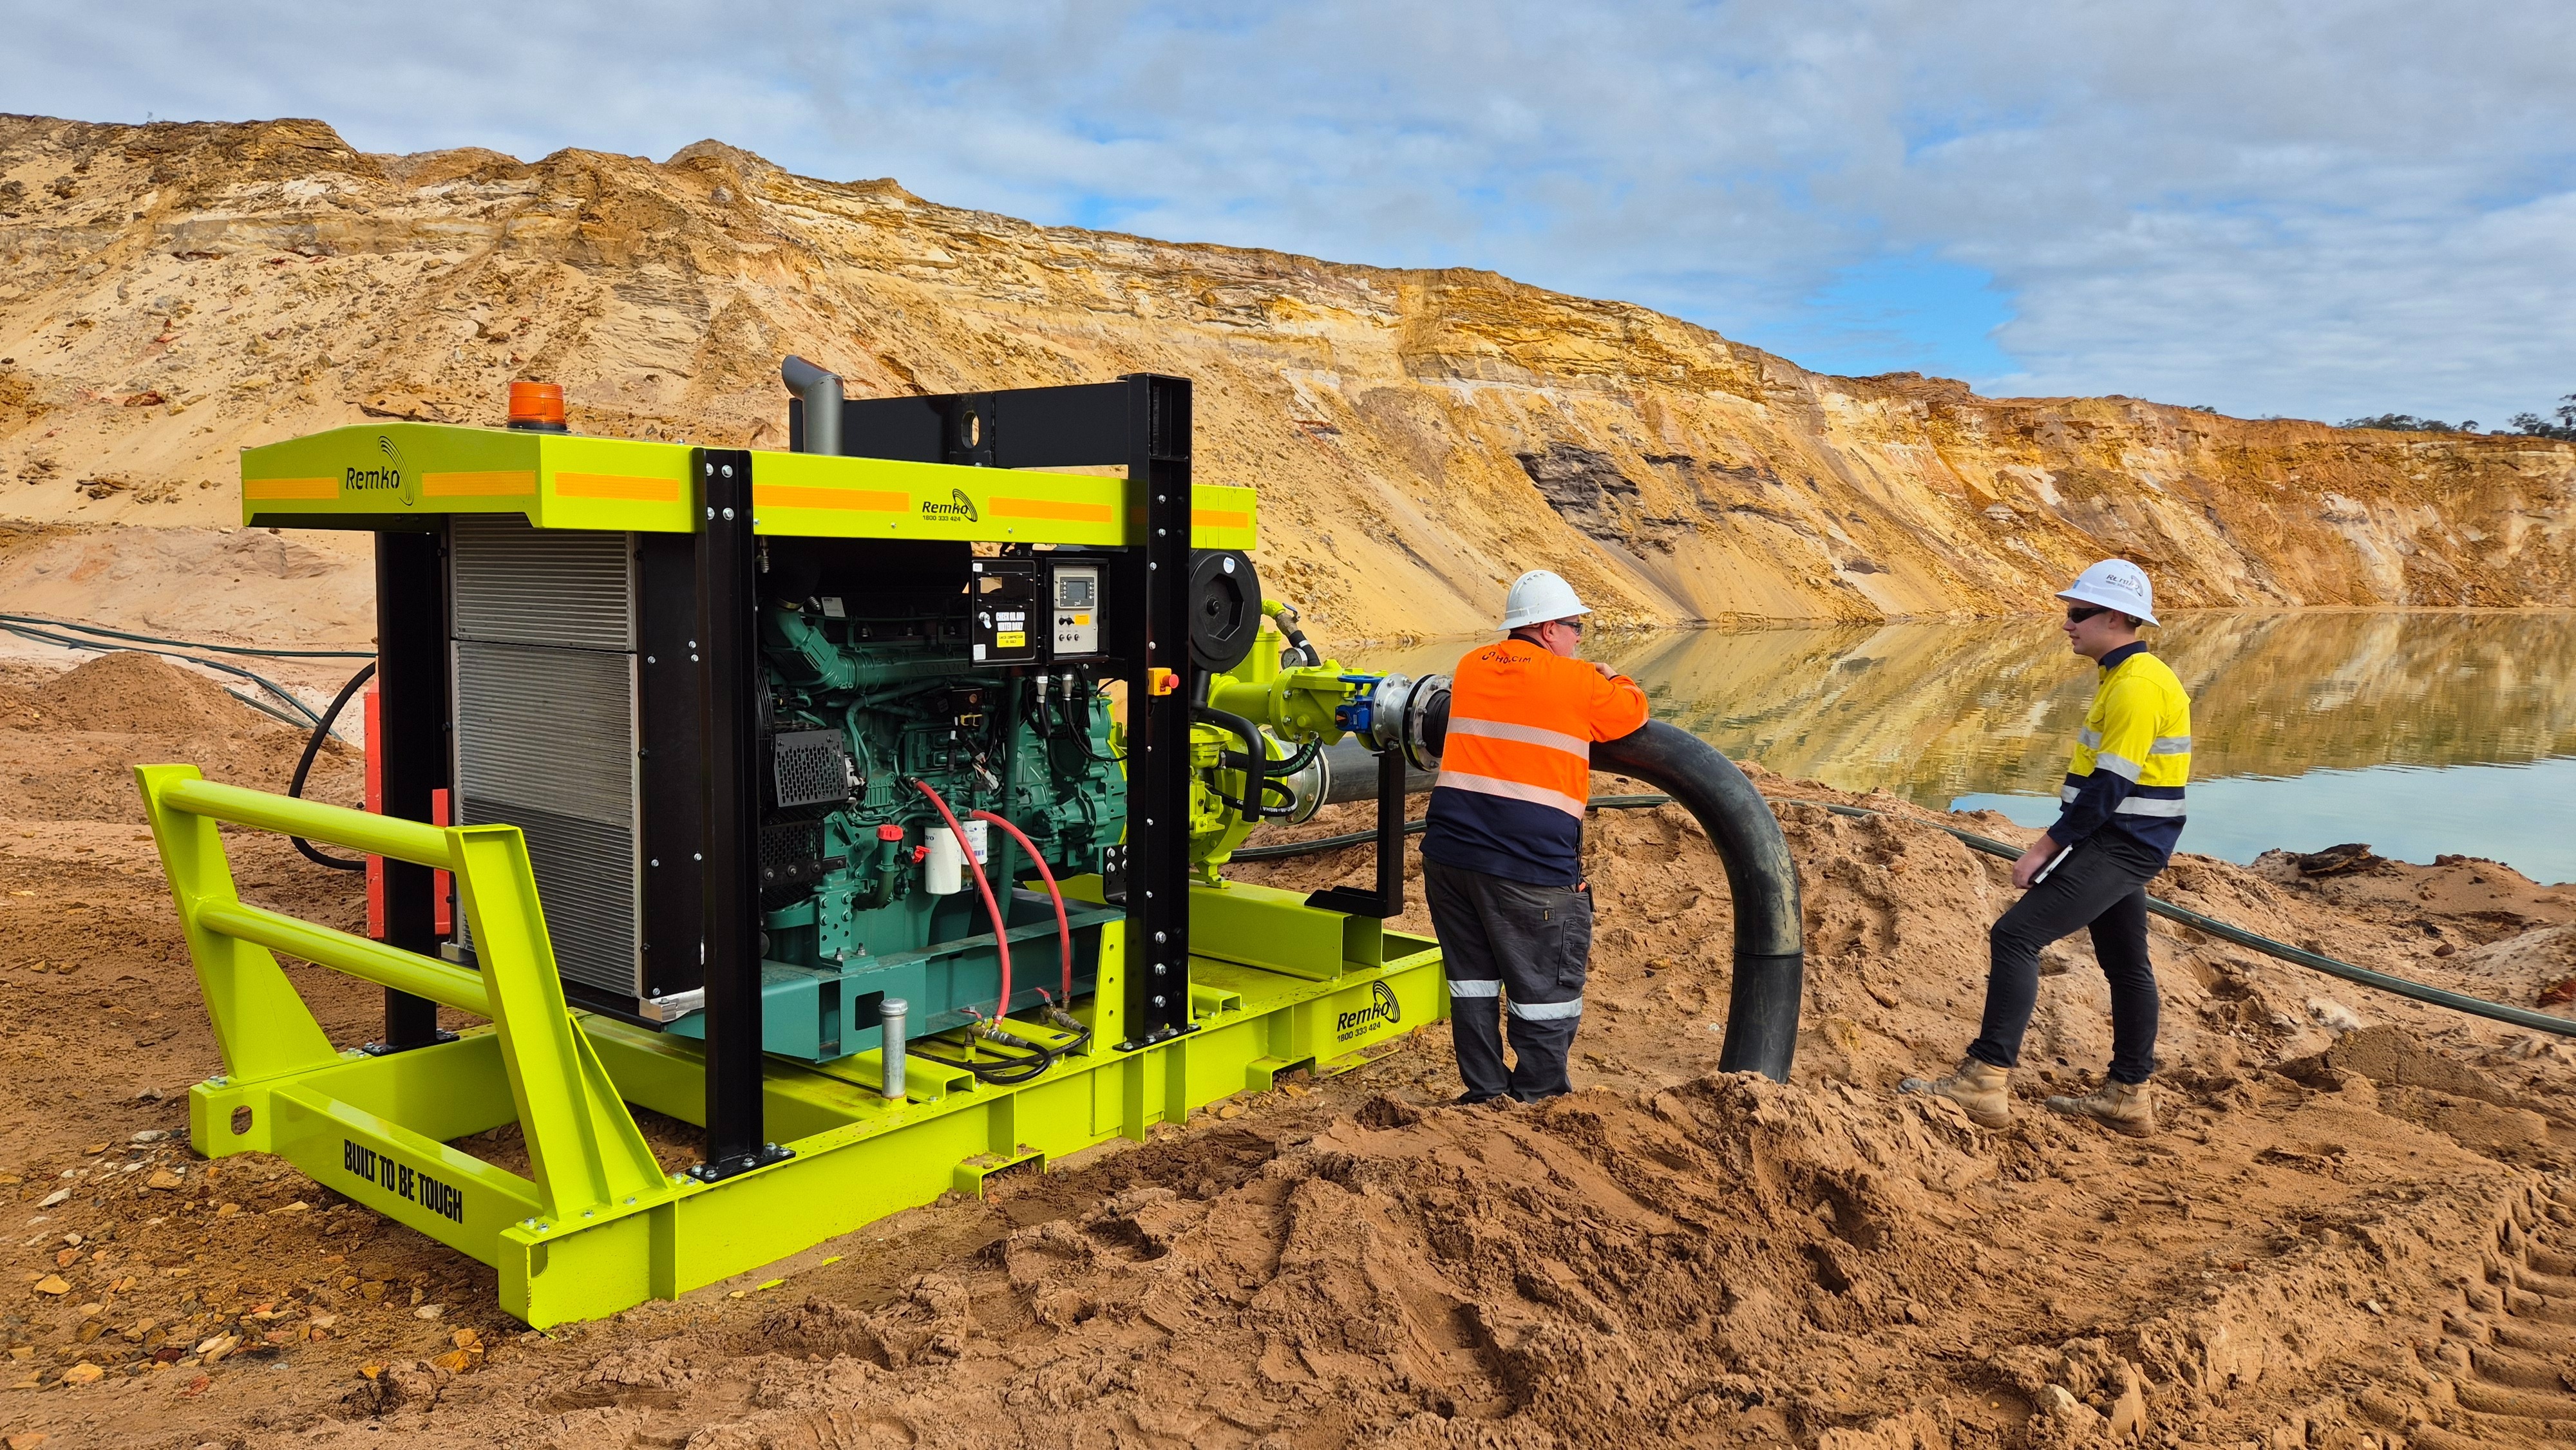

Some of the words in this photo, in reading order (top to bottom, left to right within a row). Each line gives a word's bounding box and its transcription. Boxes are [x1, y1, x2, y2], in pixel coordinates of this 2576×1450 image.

[346, 466, 400, 490] Remko
[922, 501, 969, 514] Remko
[1337, 1001, 1390, 1032] Remko
[1337, 1031, 1354, 1043] 1800
[1355, 1026, 1367, 1037] 333
[1368, 1021, 1381, 1031] 424
[344, 1138, 376, 1183] BUILT
[379, 1154, 395, 1192] TO
[399, 1163, 415, 1201] BE
[417, 1172, 462, 1224] TOUGH
